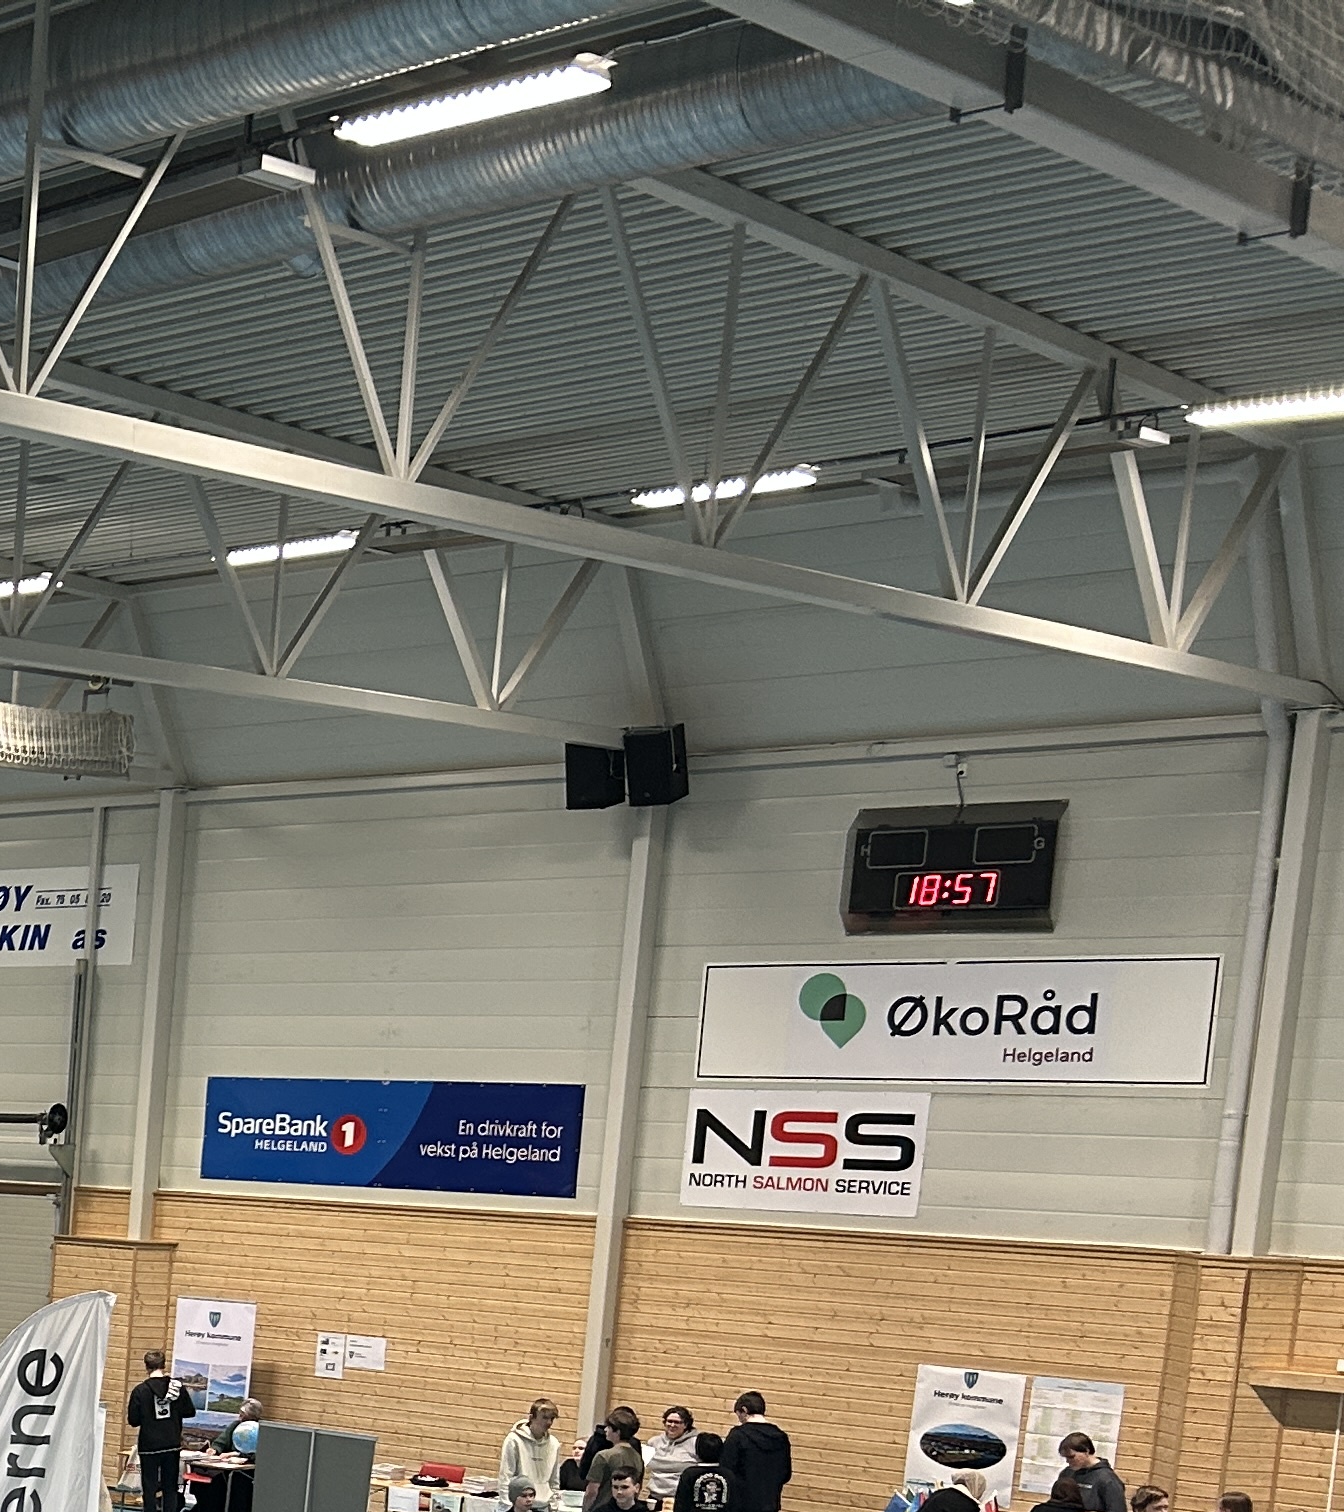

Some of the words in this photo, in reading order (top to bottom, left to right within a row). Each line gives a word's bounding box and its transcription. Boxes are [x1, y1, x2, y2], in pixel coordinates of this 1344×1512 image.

[1033, 836, 1045, 850] G
[908, 872, 998, 906] 18:57
[887, 989, 1099, 1037] ØkoRåd
[1002, 1047, 1094, 1066] Helgeland
[217, 1111, 328, 1138] SpareBank
[340, 1121, 356, 1148] 1
[459, 1120, 475, 1136] En
[478, 1120, 539, 1138] drivkraft
[540, 1121, 563, 1139] for
[691, 1108, 916, 1172] NSS
[254, 1138, 328, 1153] HELGELAND
[419, 1142, 456, 1158] vekst
[458, 1141, 479, 1162] på
[481, 1144, 561, 1163] Helgeland
[688, 1172, 747, 1188] NORTH
[752, 1175, 829, 1192] SALMON
[835, 1179, 912, 1196] SERVICE
[933, 1389, 960, 1401] Herøy
